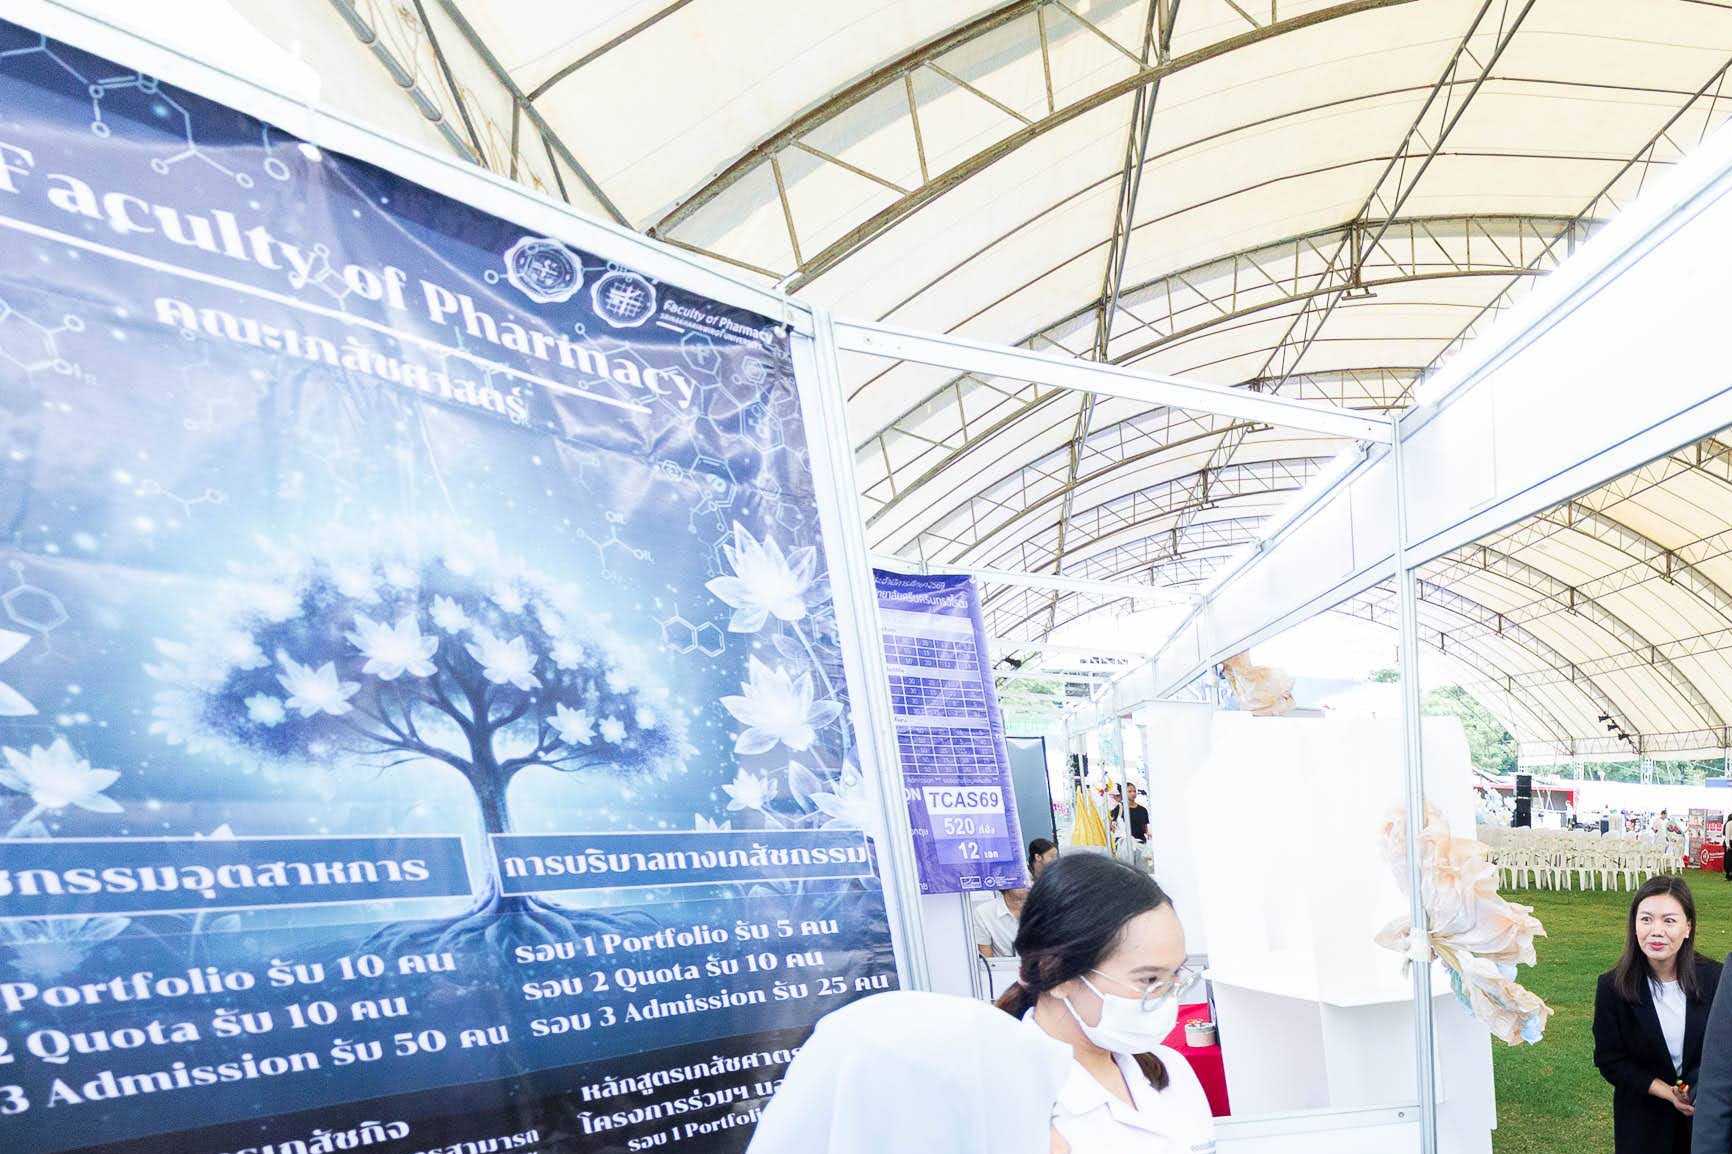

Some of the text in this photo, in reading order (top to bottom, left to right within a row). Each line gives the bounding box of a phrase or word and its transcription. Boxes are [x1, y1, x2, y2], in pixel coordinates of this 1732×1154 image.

[0, 141, 698, 408] Faculty of Pharmacy
[663, 300, 773, 344] Faculty of Pharmacy
[154, 297, 530, 421] คณะเภสัชศาสตร์
[929, 791, 999, 809] TCAS69
[943, 817, 975, 836] 520
[957, 841, 980, 860] 12
[503, 843, 867, 878] การบริบาลทางเภสัชกรรม
[515, 916, 840, 965] รอบ 1 Portfolio รับ 5 คน
[0, 950, 457, 1013] Portfolio รับ 10 คน
[521, 950, 825, 1001] รอบ 2 Quota รับ 10 คน
[26, 1017, 201, 1066] Quota
[211, 1007, 274, 1038] รับ
[284, 1000, 338, 1030] 10
[351, 994, 409, 1022] คน
[530, 972, 890, 1038] รอบ 3 Admission รับ 25 คน
[0, 1021, 510, 1115] 3 Admission รับ 50 คน
[627, 1107, 764, 1151] รอบ 1 Portfoli
